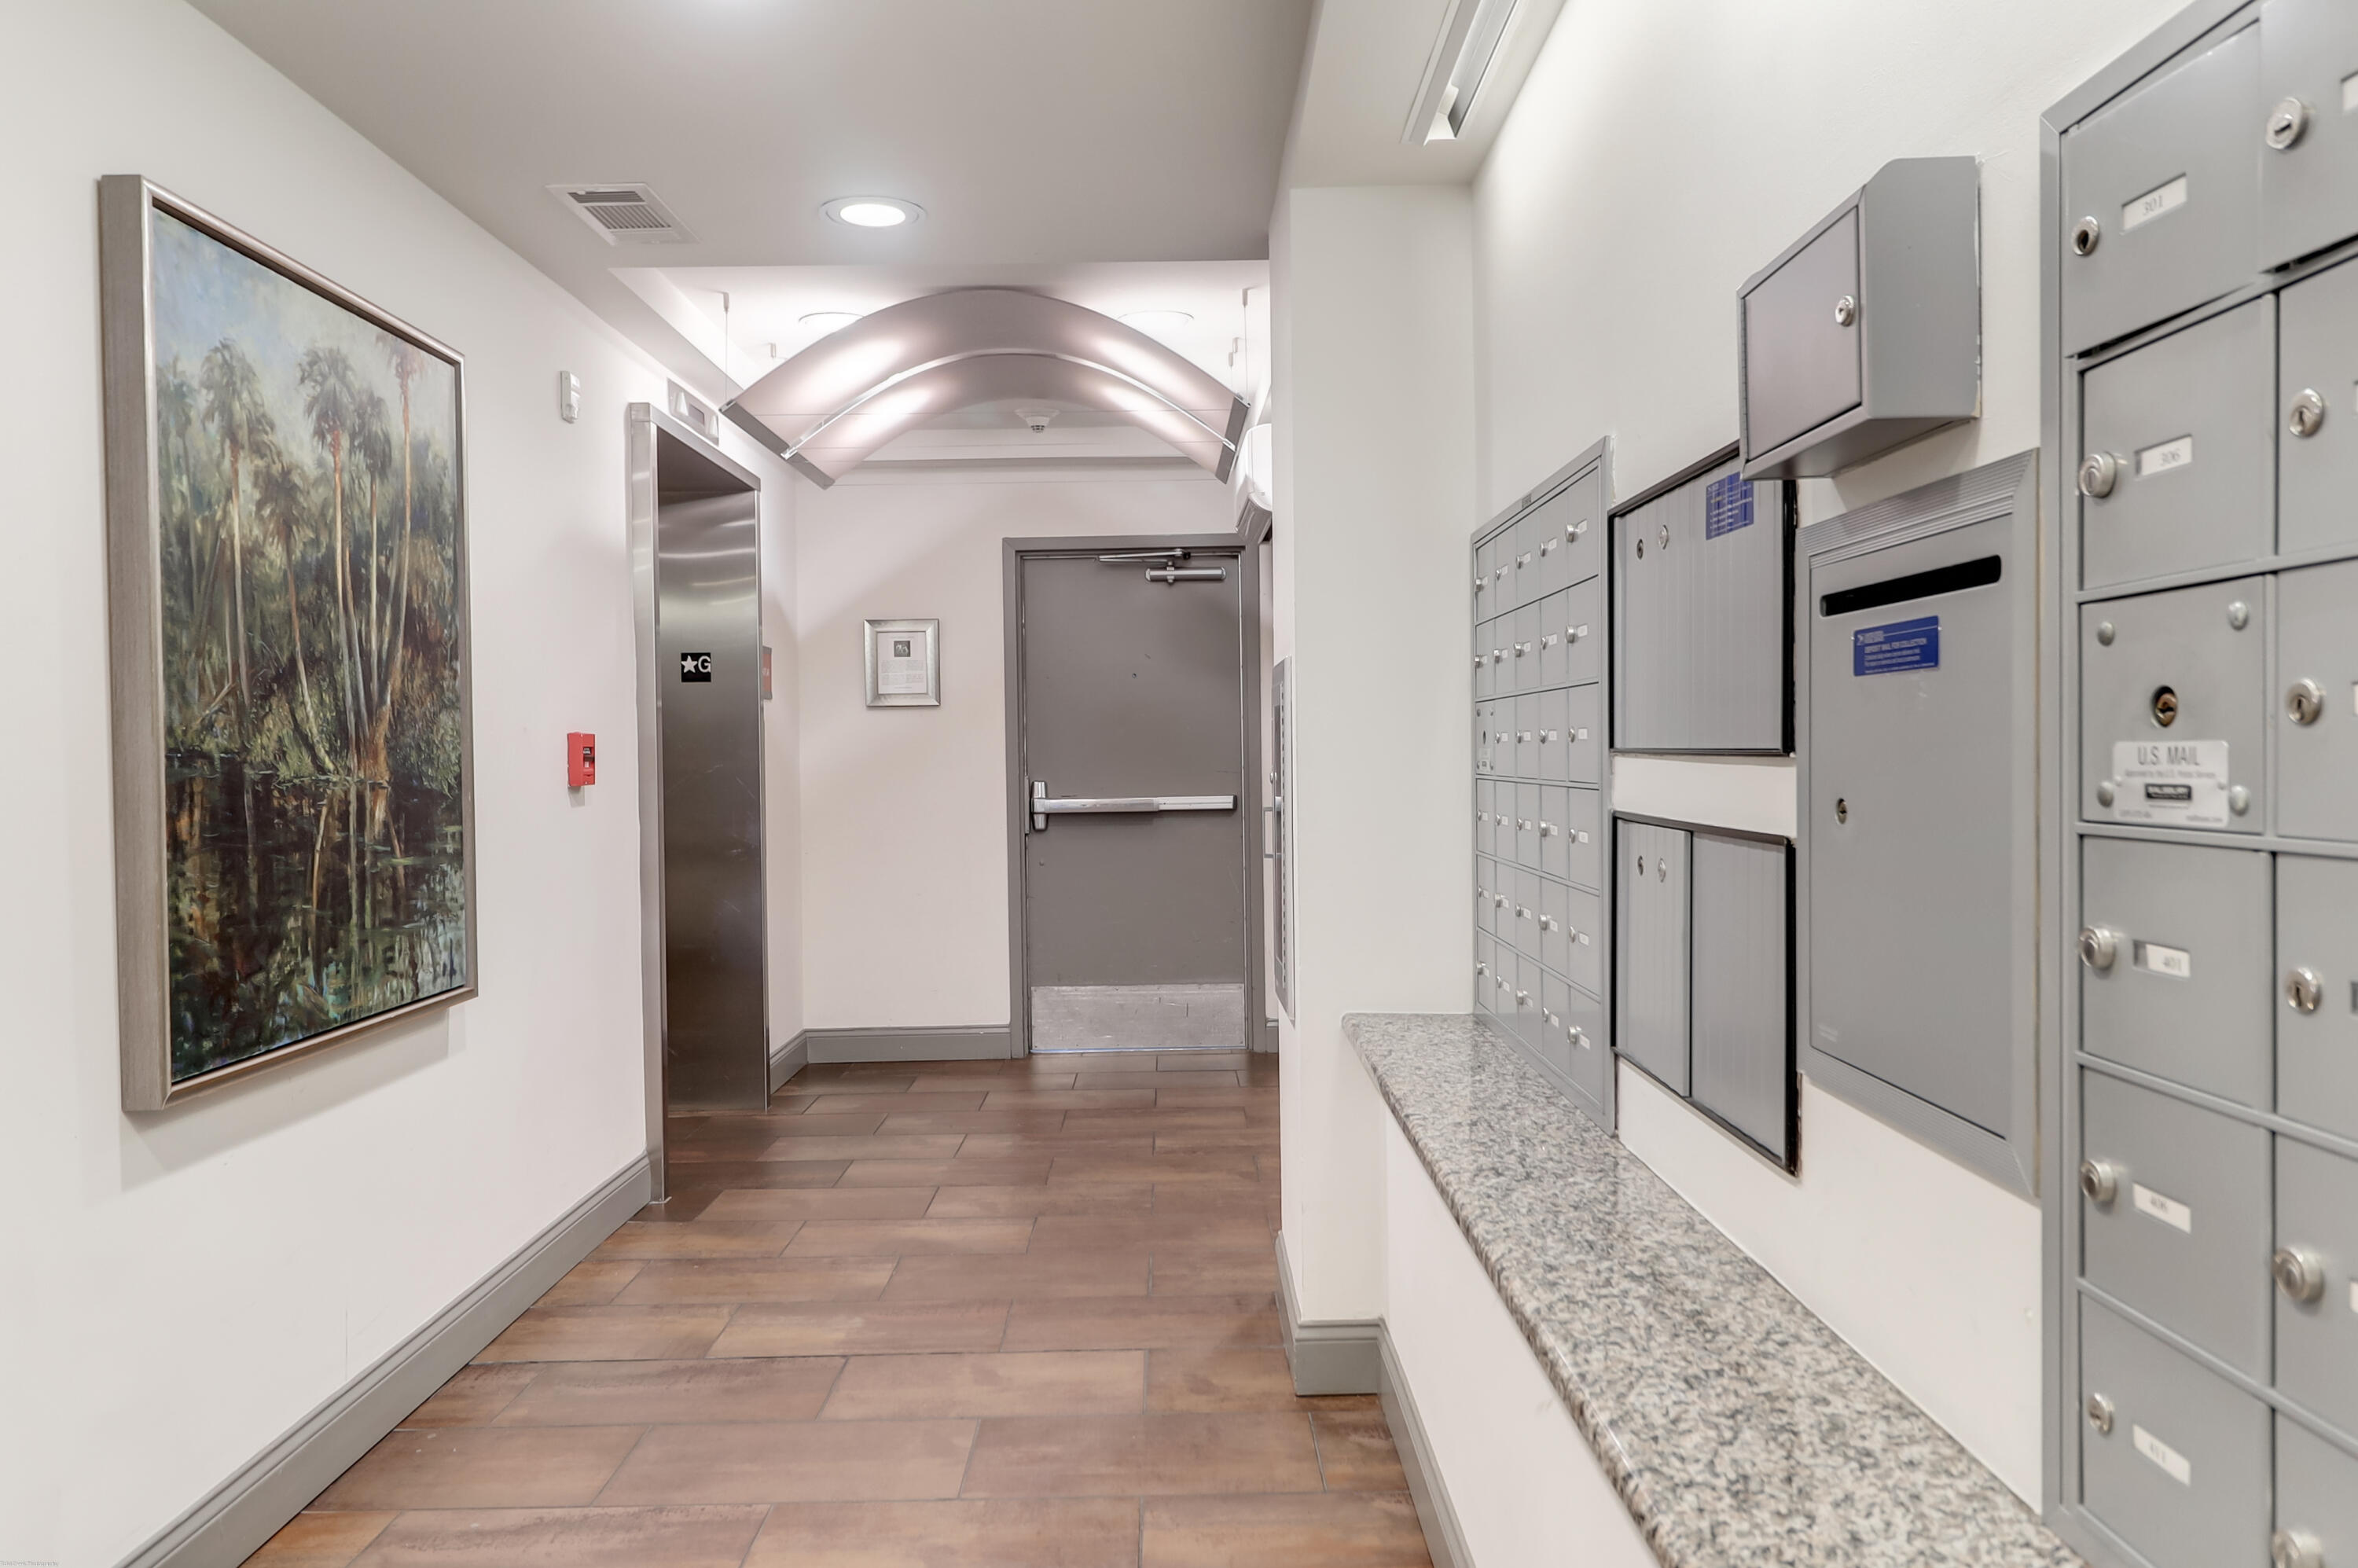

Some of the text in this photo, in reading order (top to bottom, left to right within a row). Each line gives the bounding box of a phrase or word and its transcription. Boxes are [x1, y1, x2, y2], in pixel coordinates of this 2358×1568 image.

[2143, 195, 2162, 215] 301
[698, 655, 711, 673] G
[2137, 746, 2200, 766] U.S. MAIL
